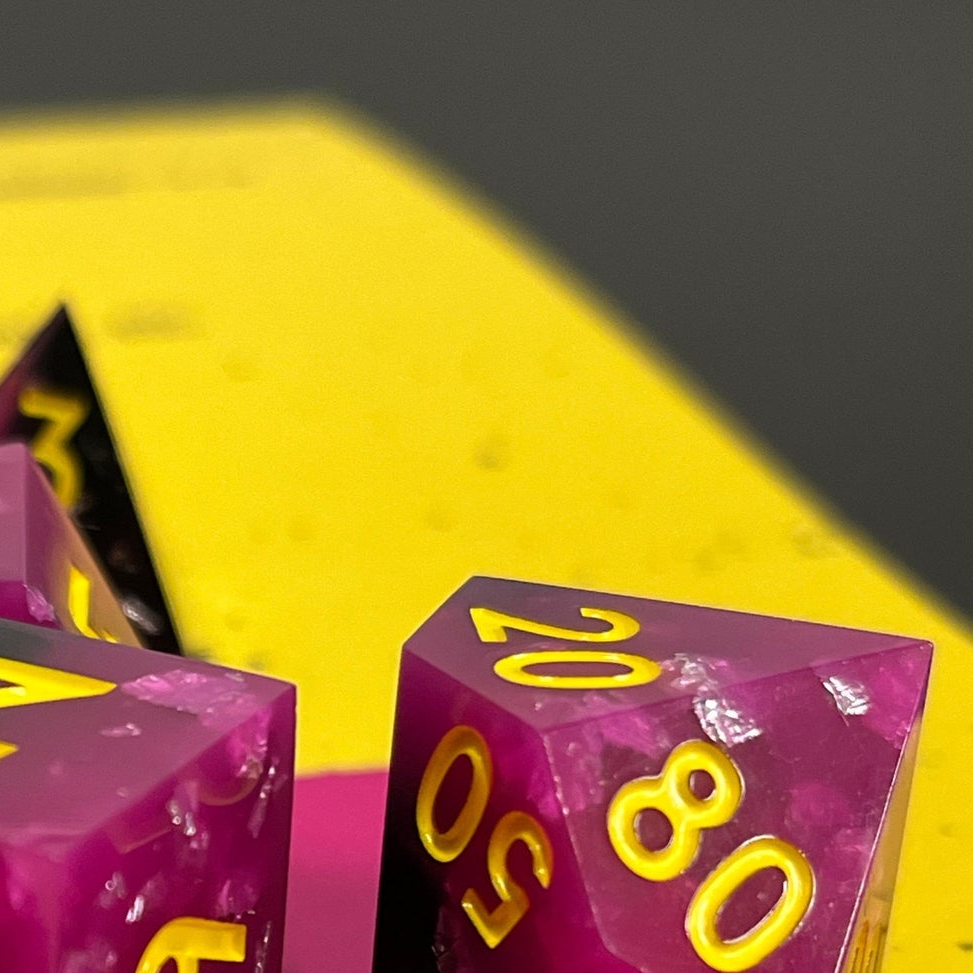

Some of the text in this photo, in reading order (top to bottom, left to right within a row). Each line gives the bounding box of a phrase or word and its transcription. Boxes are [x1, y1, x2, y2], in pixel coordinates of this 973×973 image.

[469, 606, 663, 690] 20
[416, 725, 553, 950] 50
[607, 739, 816, 973] 80
